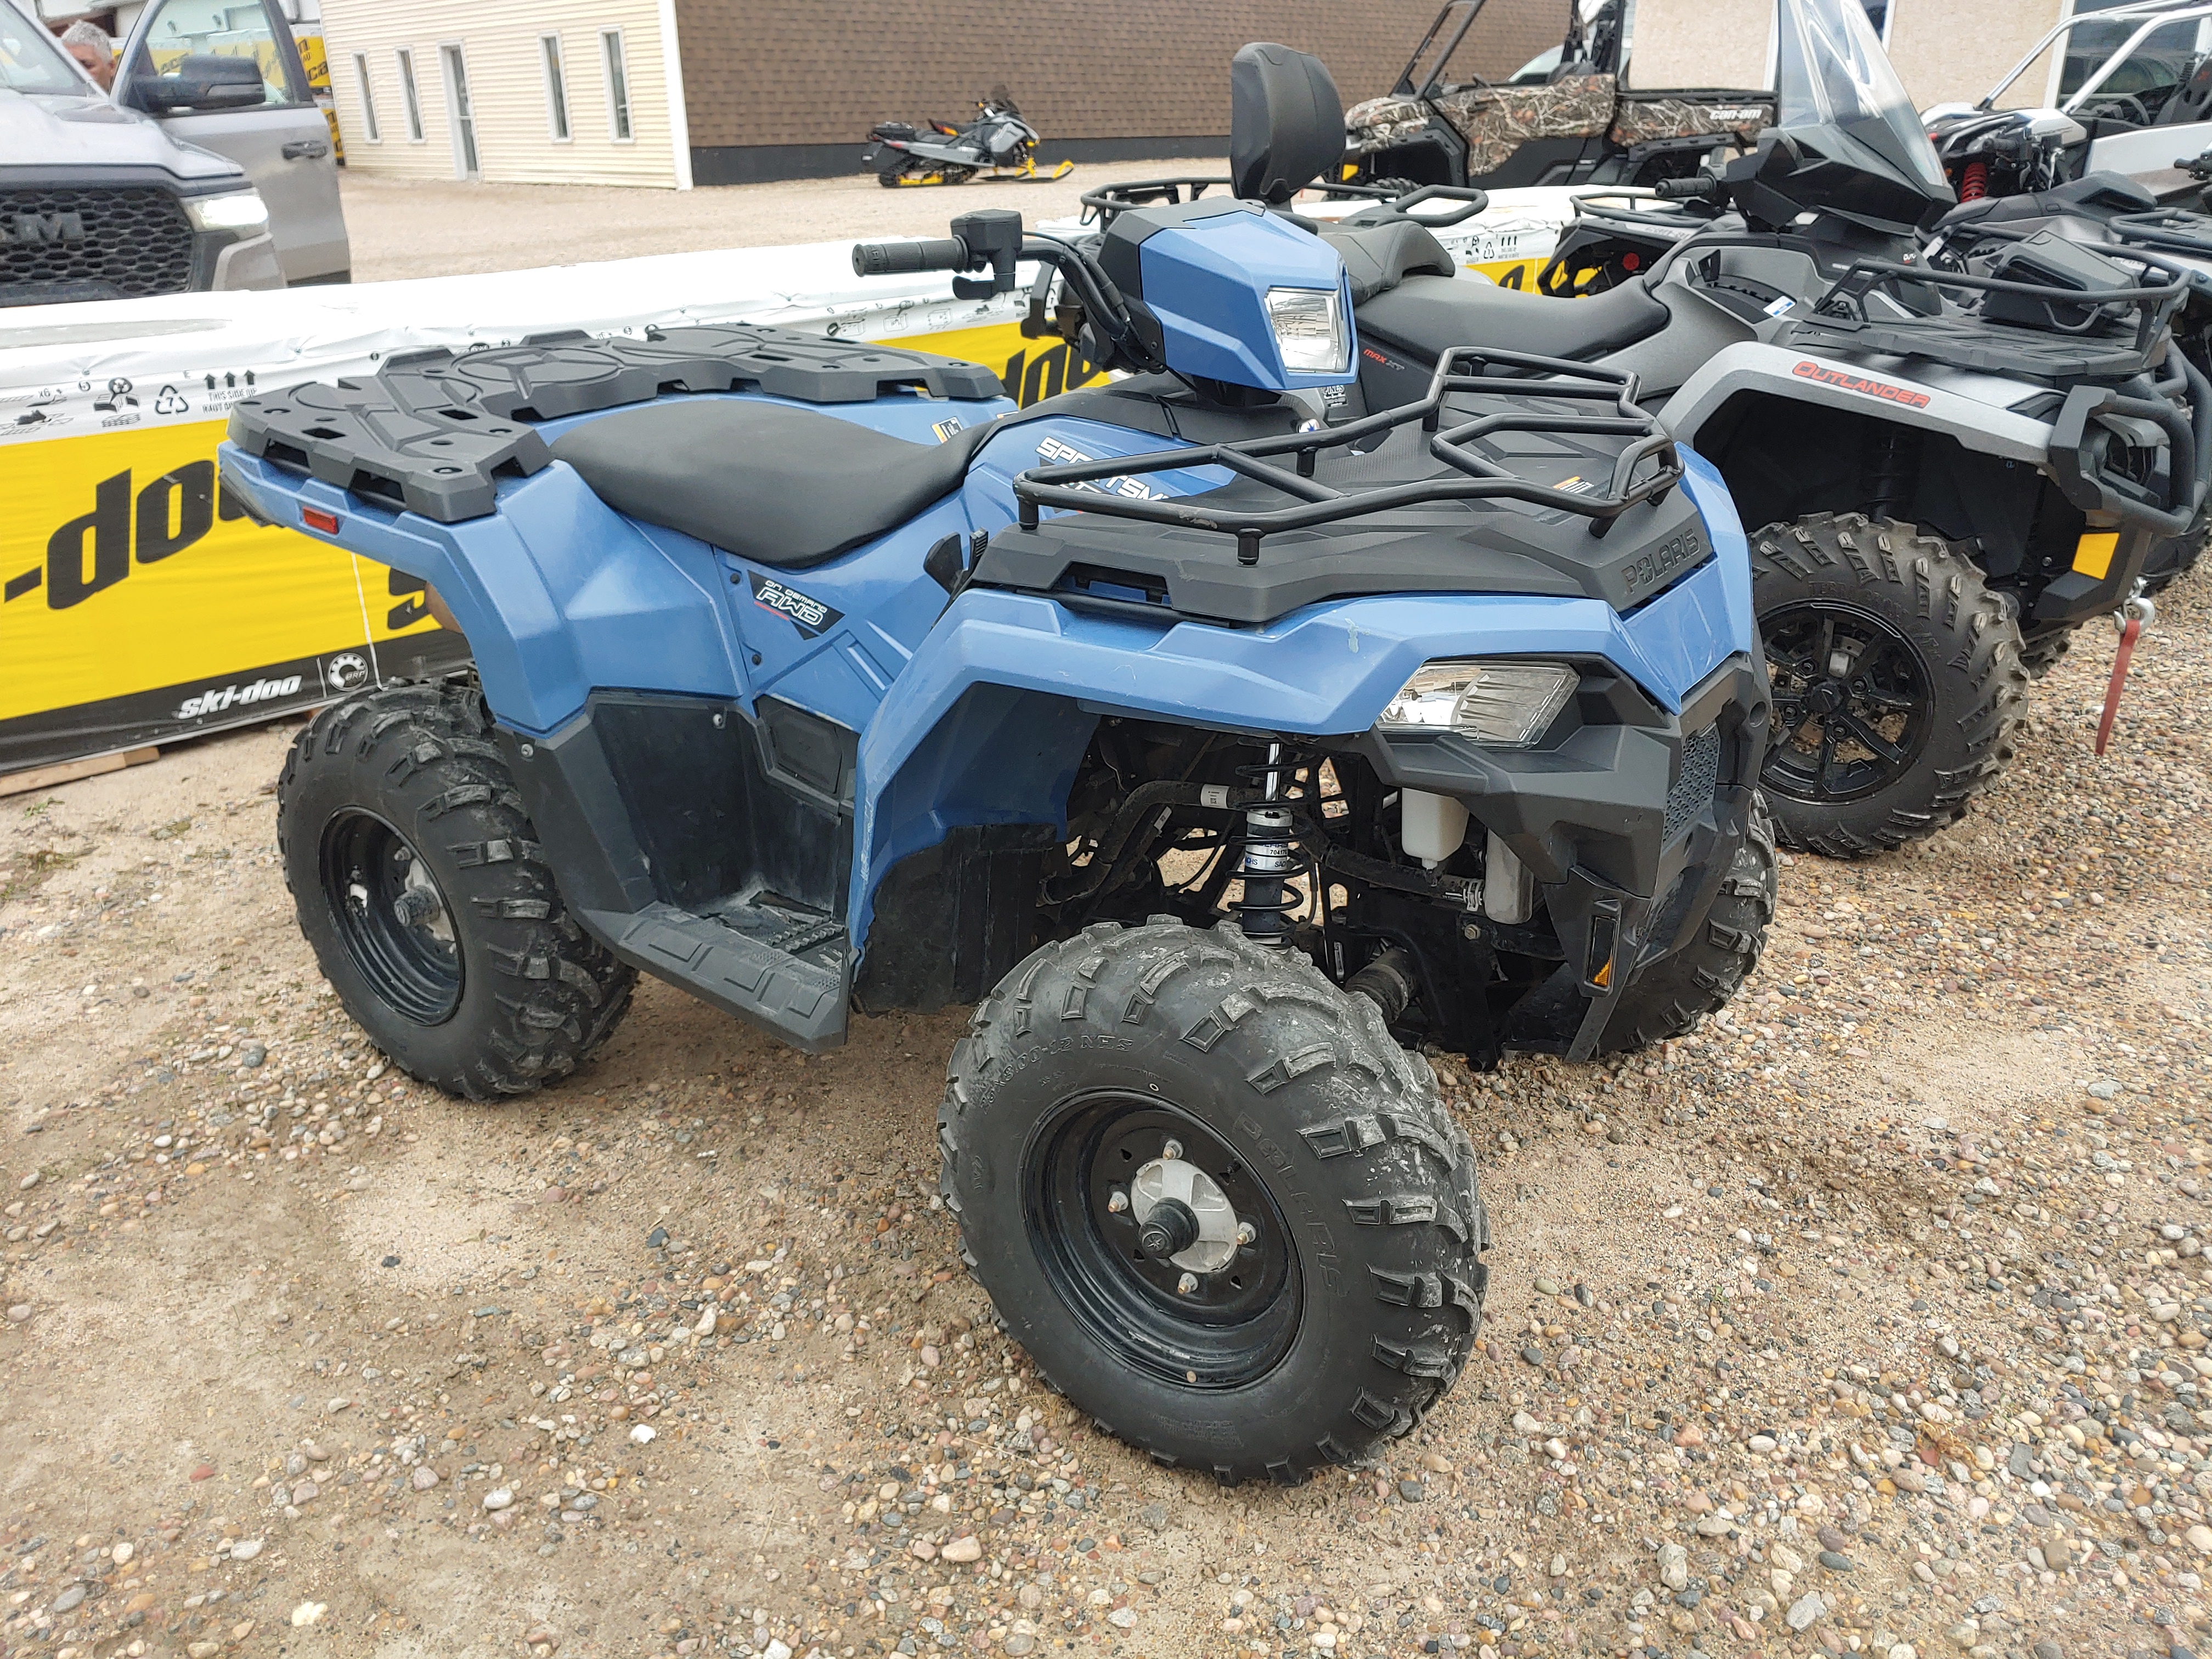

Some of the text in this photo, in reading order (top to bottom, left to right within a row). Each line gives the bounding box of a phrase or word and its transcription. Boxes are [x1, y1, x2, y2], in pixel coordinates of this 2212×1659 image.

[1709, 109, 1762, 120] can-am
[1792, 360, 1931, 409] OUTLANDER
[1621, 527, 1700, 596] POLARIS
[756, 586, 823, 625] AWD
[765, 580, 828, 613] ON DEMAND
[345, 670, 366, 681] BRP
[178, 675, 302, 719] ski-doo
